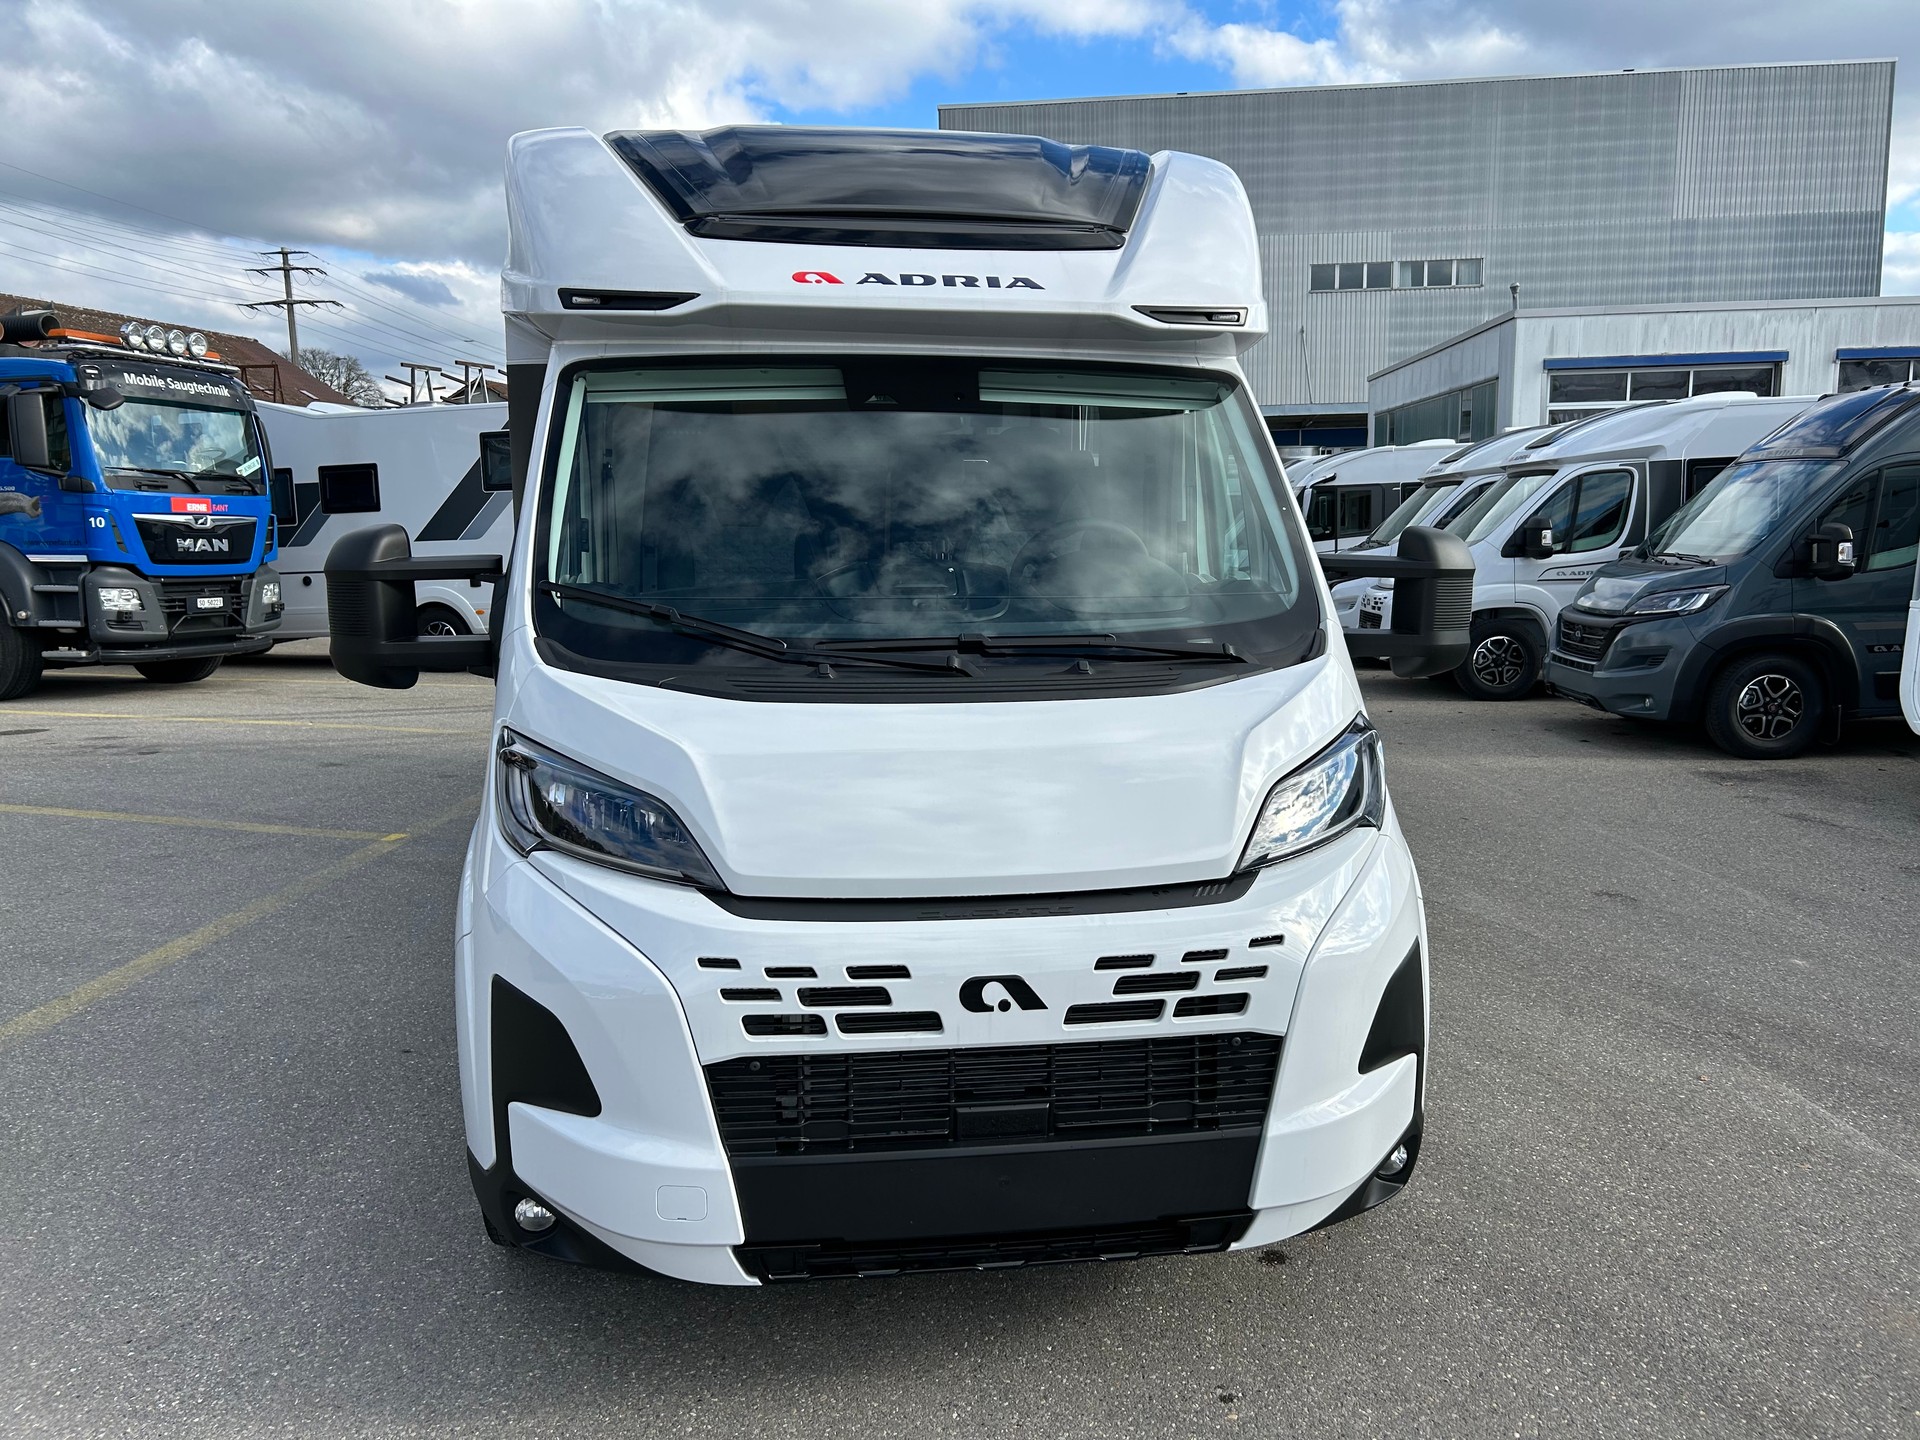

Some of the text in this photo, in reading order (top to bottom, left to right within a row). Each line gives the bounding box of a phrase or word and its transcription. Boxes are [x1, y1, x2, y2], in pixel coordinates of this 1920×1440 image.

[856, 272, 1047, 290] ADRIA
[123, 372, 231, 398] Mobile Saugtechnik
[186, 503, 229, 512] ERNE FANT
[88, 516, 106, 528] 10
[176, 538, 229, 552] MAN
